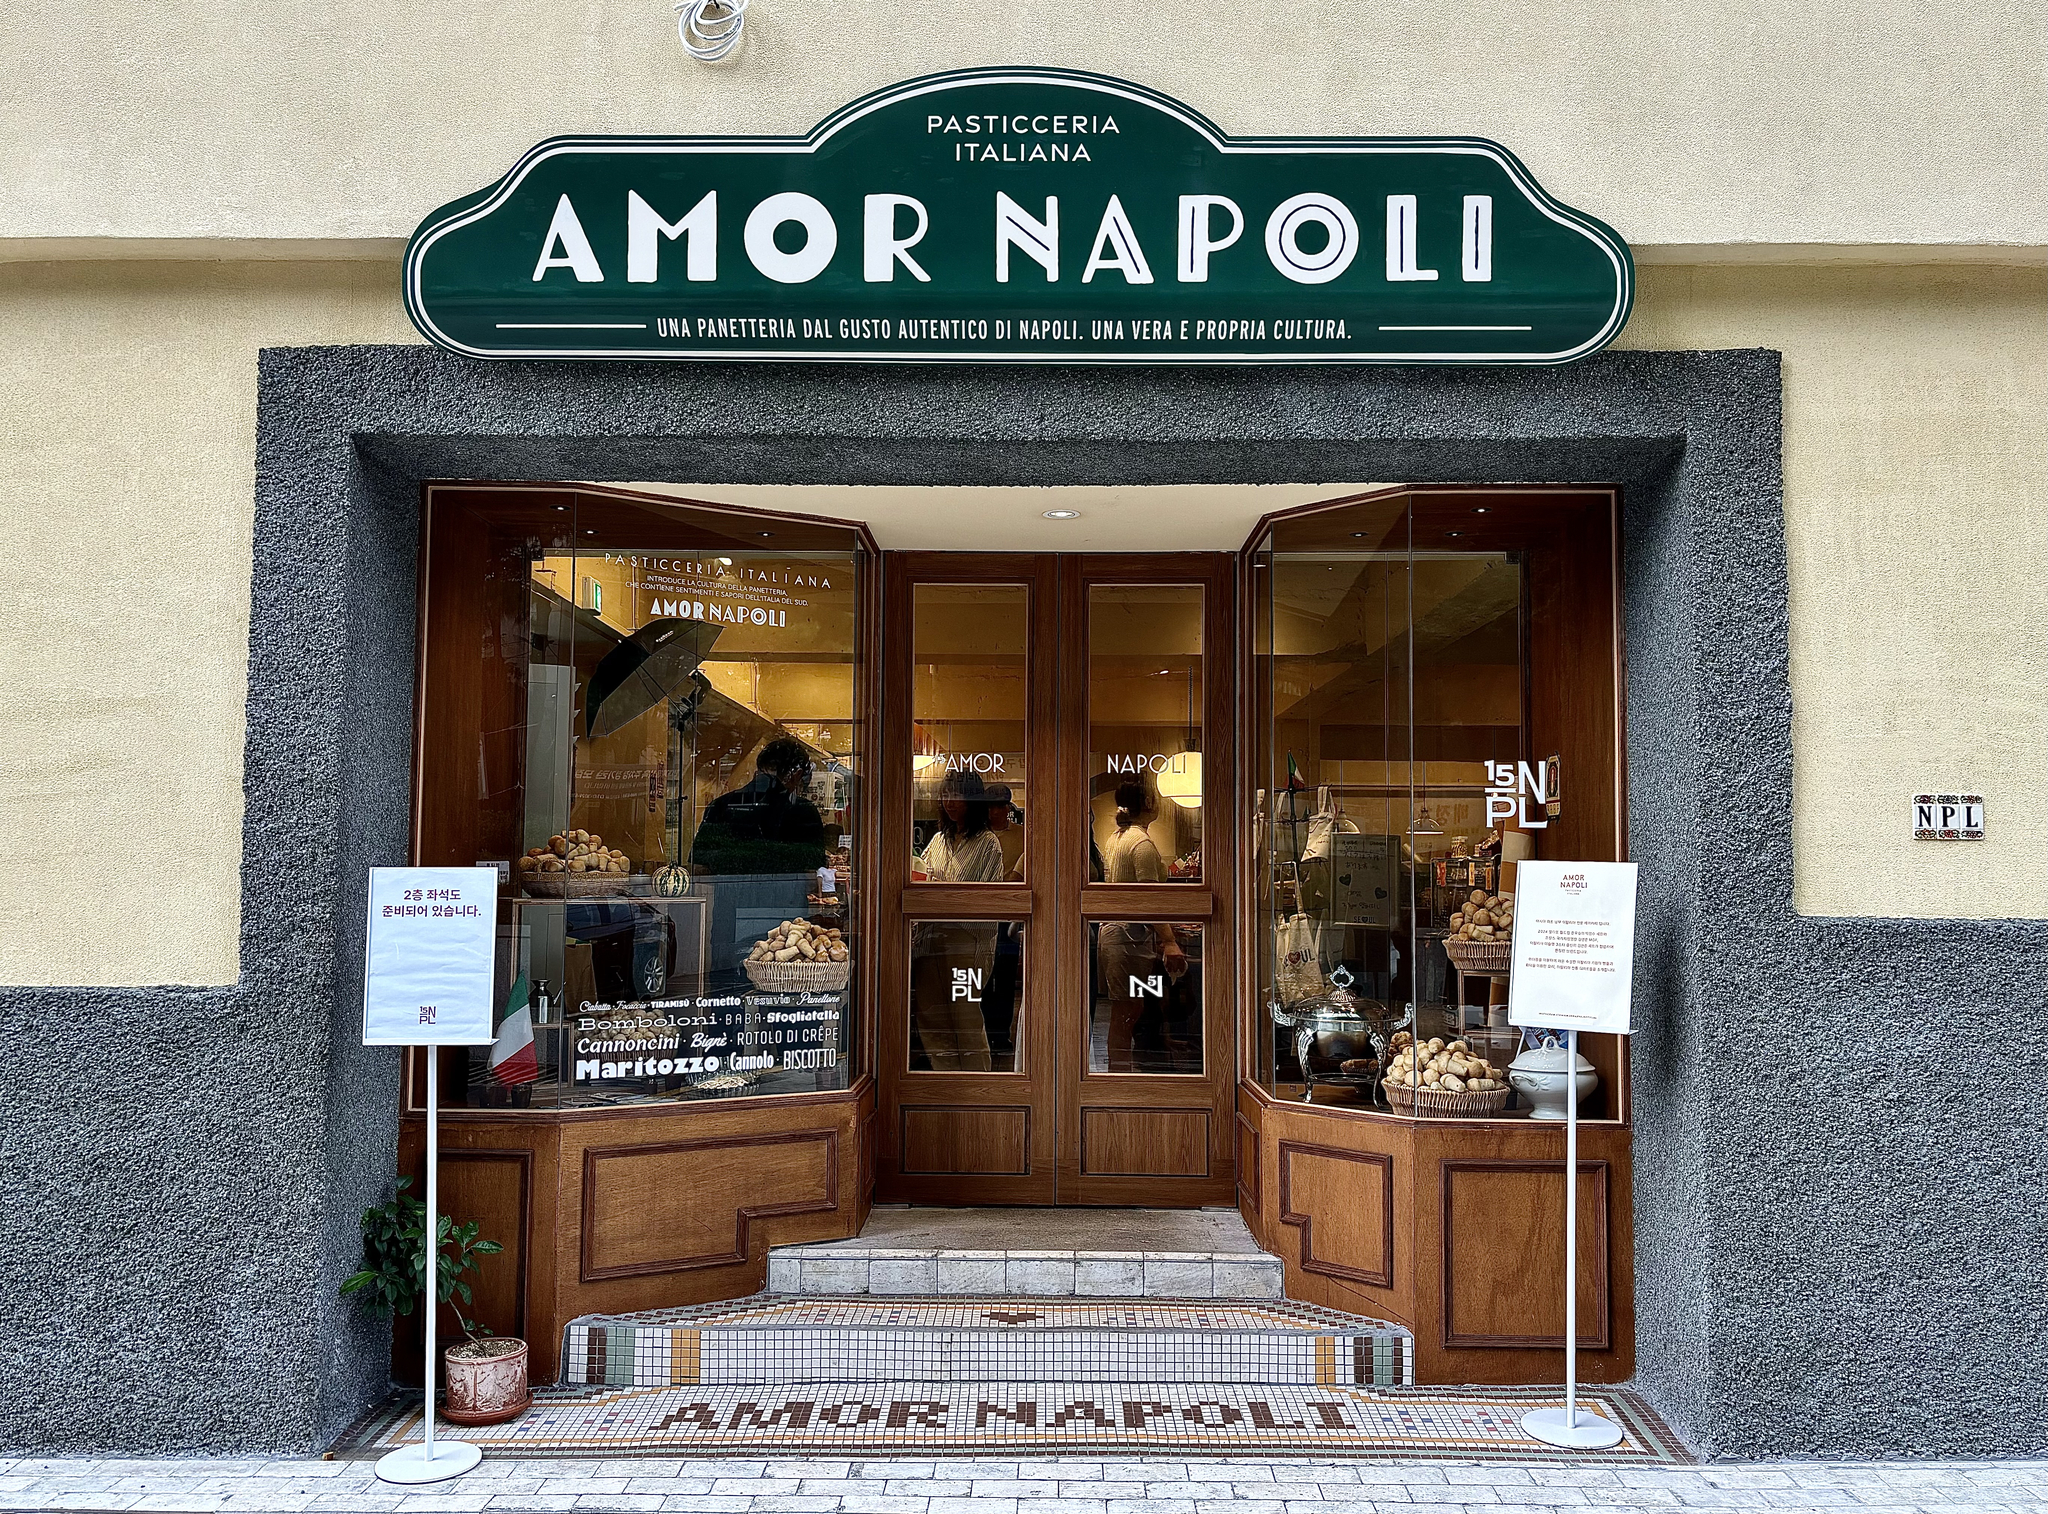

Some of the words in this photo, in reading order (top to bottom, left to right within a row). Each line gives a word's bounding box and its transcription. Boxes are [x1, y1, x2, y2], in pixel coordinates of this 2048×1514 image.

[927, 115, 1120, 134] PASTICCERIA
[955, 143, 1092, 162] ITALIANA
[532, 189, 932, 284] AMOR
[996, 190, 1493, 285] NAPOLI
[657, 317, 691, 338] UNA
[697, 318, 797, 339] PANETTERIA
[802, 318, 833, 339] DAL
[839, 318, 891, 339] GUSTO
[898, 319, 988, 340] AUTENTICO
[995, 319, 1011, 340] DI
[1019, 319, 1084, 340] NAPOLI.
[1091, 320, 1124, 340] UNA
[1131, 320, 1172, 340] VERA
[1180, 320, 1189, 340] E
[1196, 319, 1266, 340] PROPRIA
[1273, 319, 1352, 340] CULTURA.
[605, 552, 726, 577] PASTICCERIA
[740, 567, 831, 589] ITALIANA
[625, 581, 640, 590] CHE
[640, 582, 675, 593] CONTIENE
[675, 586, 714, 598] SENTIMENTI
[715, 590, 720, 598] E
[720, 591, 745, 600] SAPORI
[745, 594, 781, 604] DELL'ITALIA
[646, 574, 686, 587] INTRODUCE
[687, 579, 696, 587] LA
[697, 580, 727, 590] CULTURA
[728, 582, 748, 592] DELLA
[650, 597, 704, 620] AMOR
[709, 602, 786, 628] NAPOLI
[944, 752, 1006, 774] AMOR
[1107, 753, 1186, 774] NAPOLI
[403, 889, 424, 901] 2층
[426, 888, 462, 901] 좌석도
[1560, 881, 1588, 889] NAPOLI
[382, 904, 428, 918] 준비되어
[431, 904, 482, 918] 있습니다.
[614, 1000, 647, 1011] Focaccia
[695, 995, 741, 1009] Cornetto
[746, 993, 791, 1006] Vesuvio
[577, 1013, 718, 1031] Bomboloni
[725, 1012, 761, 1026] BABA
[766, 1009, 840, 1024] Sfogliatella
[577, 1033, 680, 1054] Cannoncini
[690, 1032, 728, 1053] Bignè
[737, 1029, 783, 1046] ROTOLO
[786, 1028, 798, 1043] DI
[802, 1025, 839, 1042] CRÊPE
[575, 1056, 720, 1081] Maritozzo
[730, 1049, 775, 1072] Cannolo
[783, 1047, 837, 1071] BISCOTTO
[649, 1401, 949, 1430] AMOR
[975, 1400, 1356, 1430] NAPOLI
